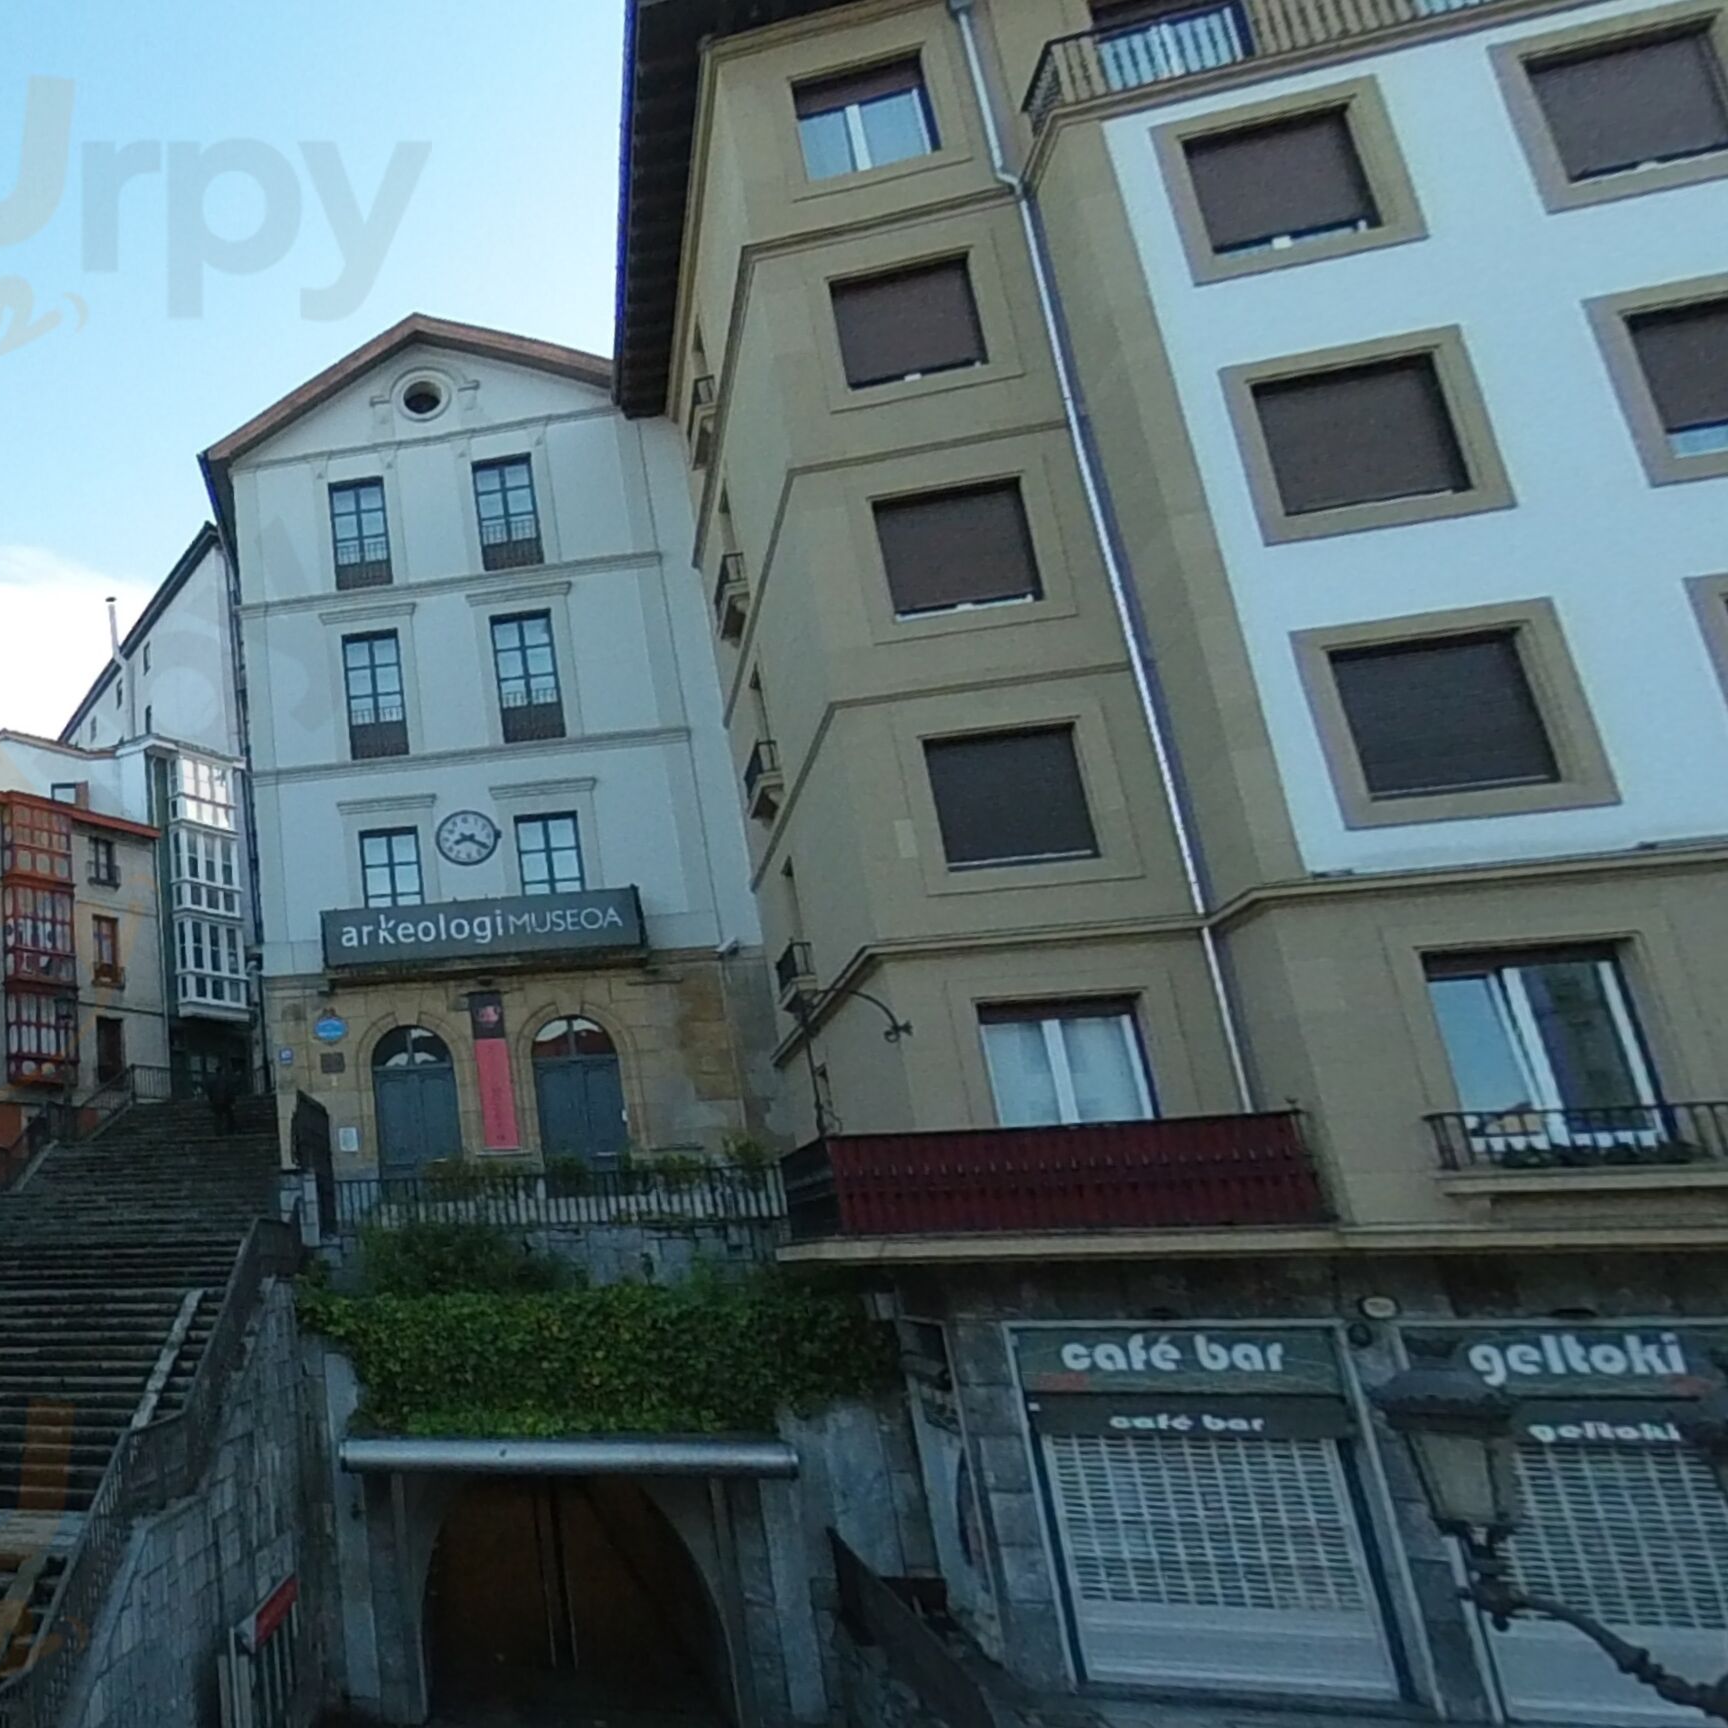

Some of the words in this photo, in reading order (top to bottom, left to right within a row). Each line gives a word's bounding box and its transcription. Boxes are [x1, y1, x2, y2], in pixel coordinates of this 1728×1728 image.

[340, 908, 503, 948] arkeologi
[509, 906, 624, 935] MUSEOA
[1061, 1333, 1182, 1372] café
[1193, 1334, 1285, 1372] bar
[1467, 1331, 1688, 1387] geltoki
[1109, 1413, 1194, 1431] café
[1201, 1414, 1265, 1432] bar
[1528, 1420, 1683, 1443] geltoki
